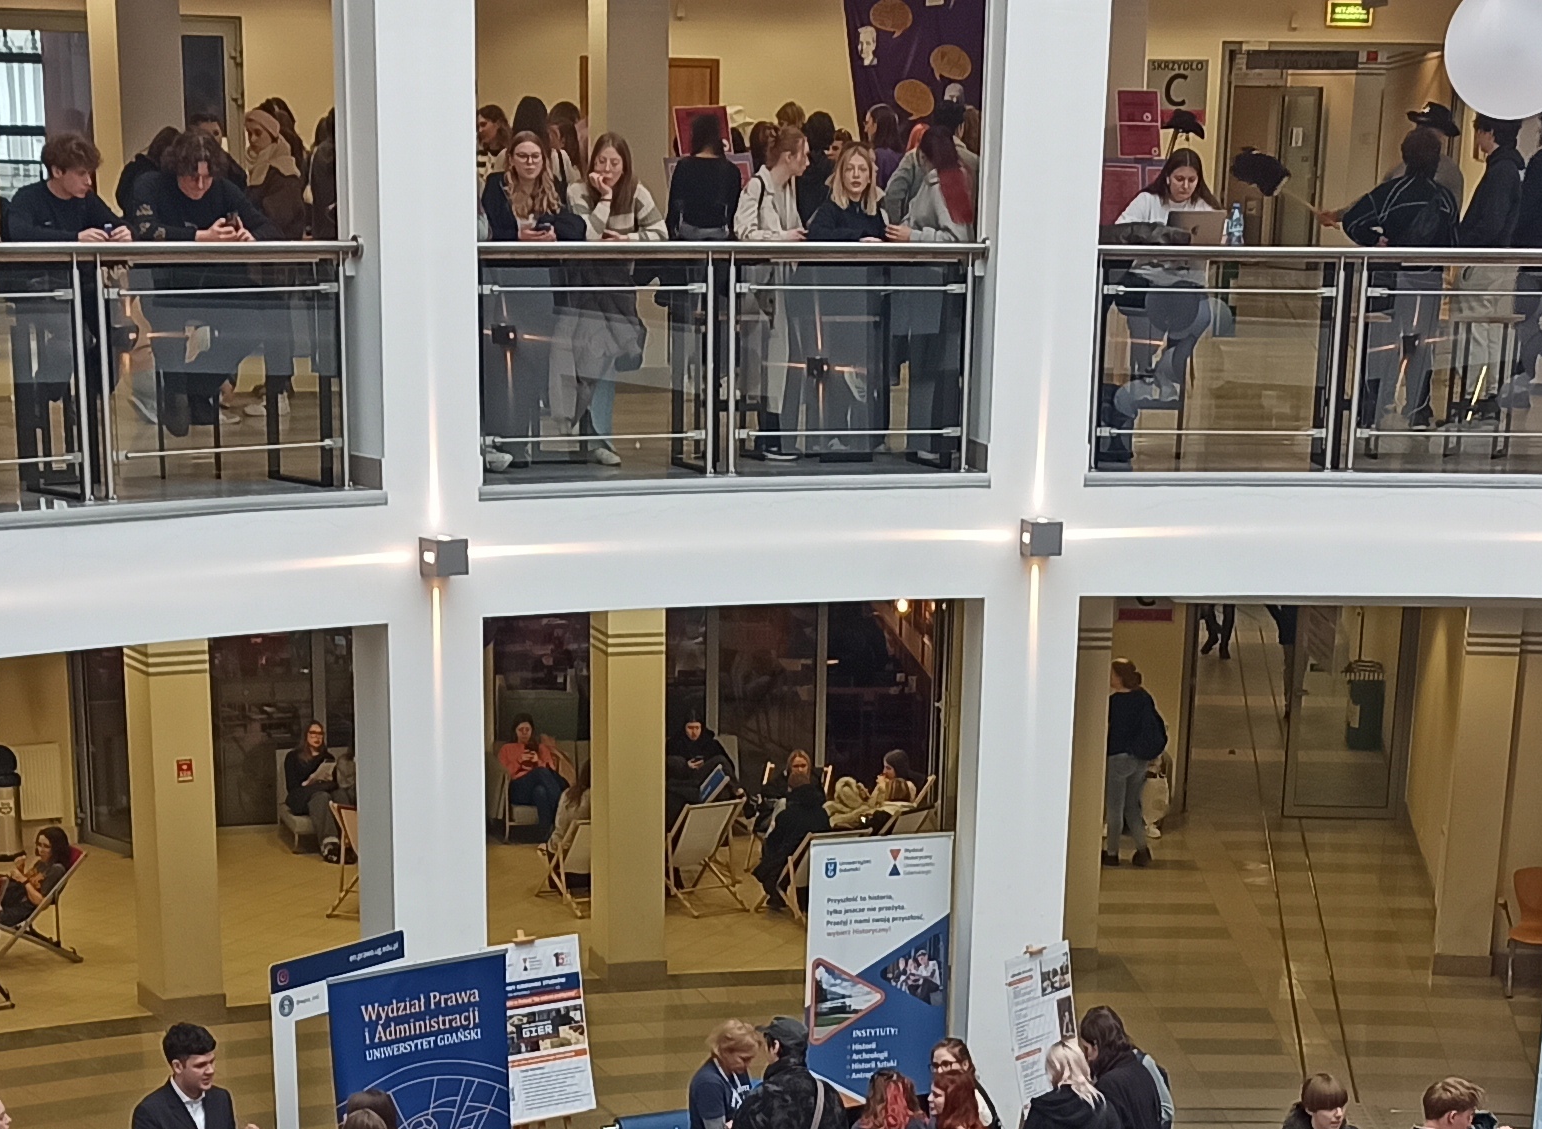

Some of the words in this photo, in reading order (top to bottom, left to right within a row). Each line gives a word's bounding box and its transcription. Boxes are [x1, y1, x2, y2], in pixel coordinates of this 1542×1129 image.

[1164, 73, 1189, 107] C
[361, 994, 425, 1024] Wydział
[429, 989, 479, 1009] Prawa
[365, 1027, 370, 1044] i
[375, 1007, 479, 1043] Administracji
[522, 1025, 553, 1038] GIER
[366, 1037, 436, 1060] UNIWERSYTET
[437, 1028, 481, 1046] GDAŃSKI
